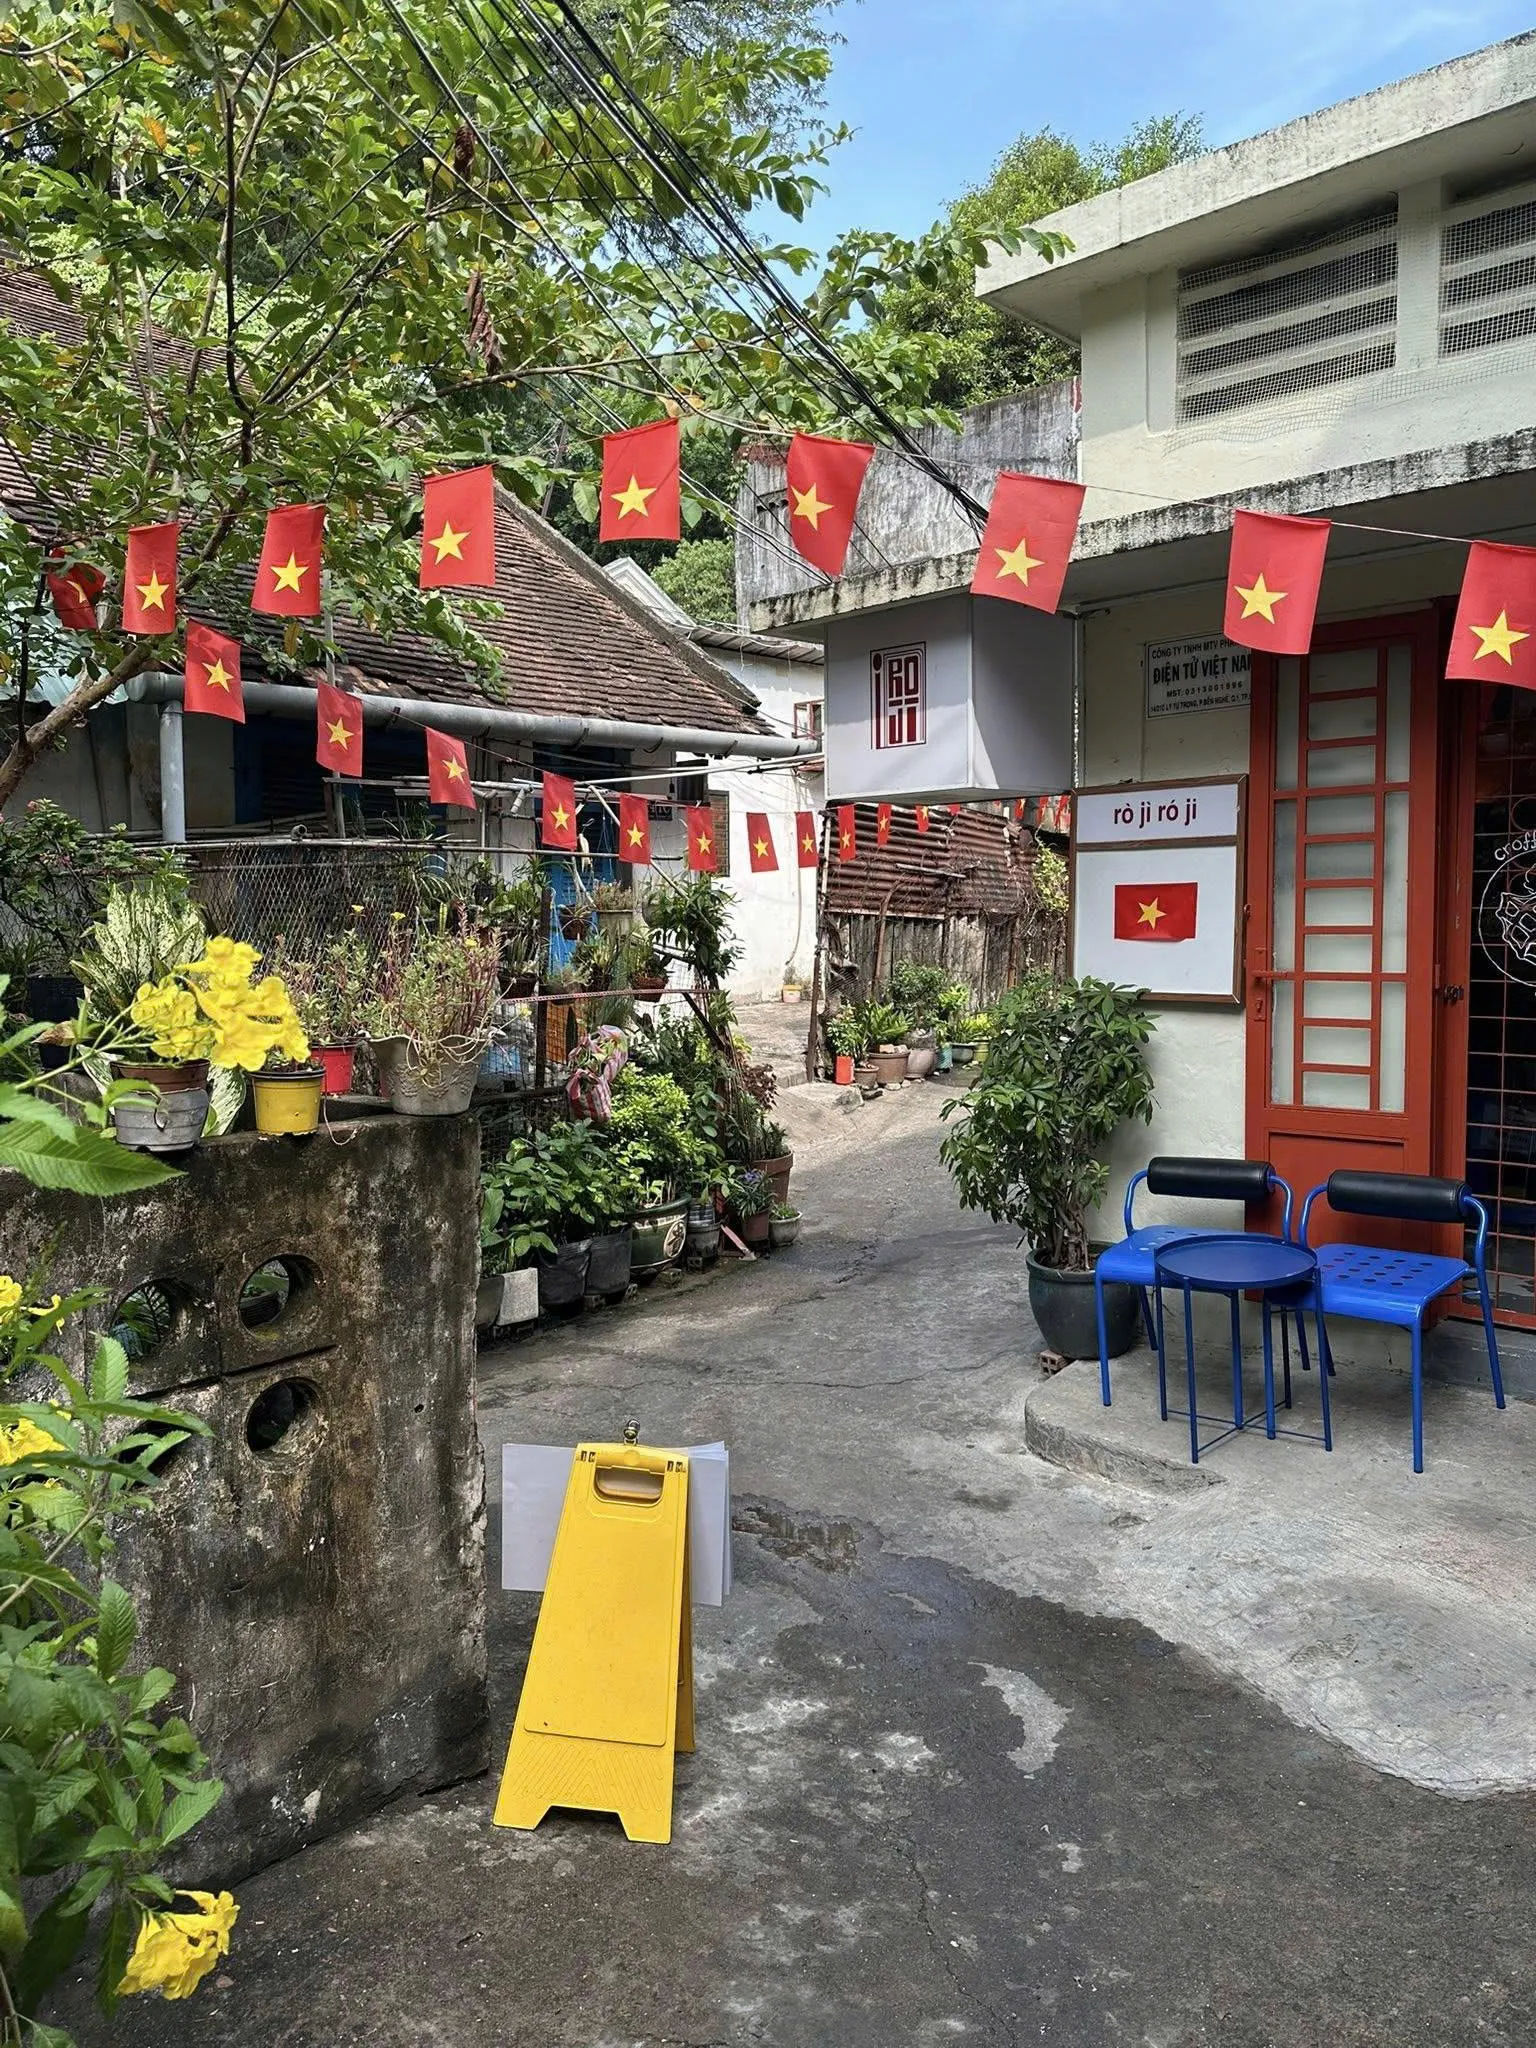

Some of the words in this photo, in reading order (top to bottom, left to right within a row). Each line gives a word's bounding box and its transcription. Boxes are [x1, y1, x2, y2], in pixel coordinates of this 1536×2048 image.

[1152, 646, 1171, 659] CÔNG
[1173, 646, 1182, 656] TY
[1184, 643, 1201, 655] TNHH
[1153, 662, 1180, 686] ĐIỆN
[1182, 655, 1199, 680] TỬ
[1201, 654, 1228, 679] VIỆT
[1114, 803, 1134, 825] rò
[1139, 801, 1151, 829] jì
[1158, 799, 1179, 822] ró
[1185, 798, 1197, 826] ji
